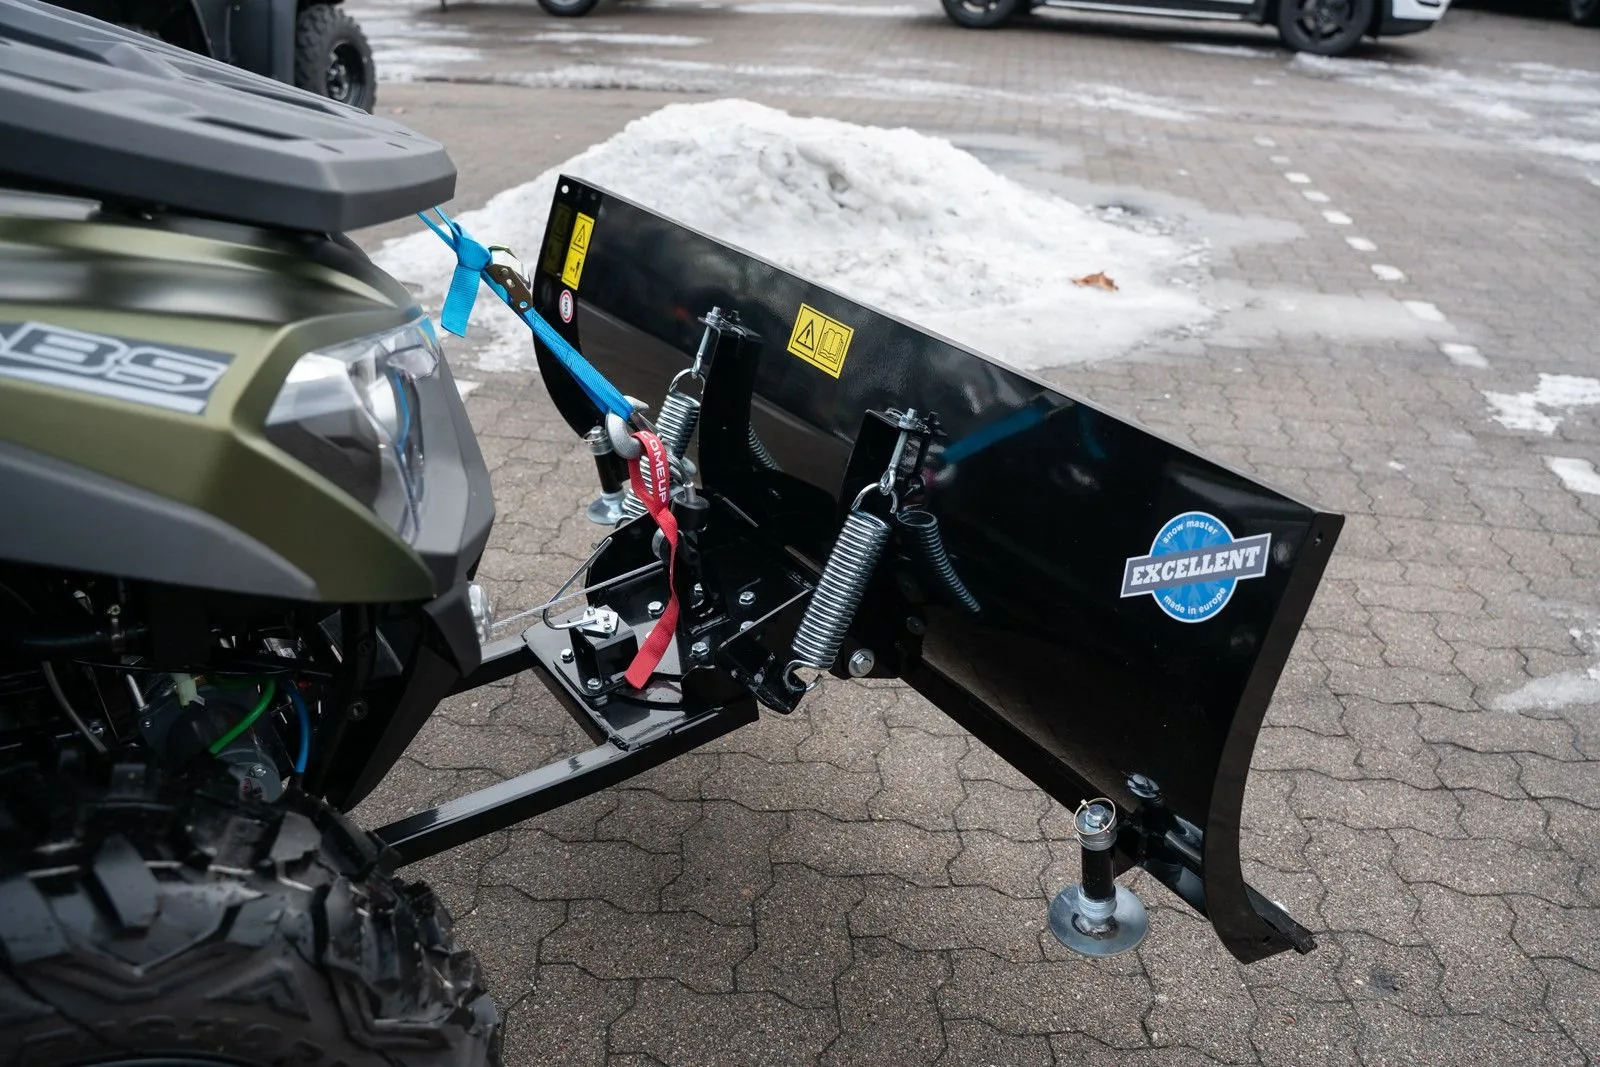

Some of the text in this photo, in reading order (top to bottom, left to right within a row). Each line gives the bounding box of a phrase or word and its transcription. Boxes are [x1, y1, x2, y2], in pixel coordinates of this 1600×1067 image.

[640, 430, 668, 503] COMEUP
[1163, 520, 1219, 544] snow master
[1130, 546, 1262, 586] EXCELLENT
[1163, 587, 1227, 615] made in europe
